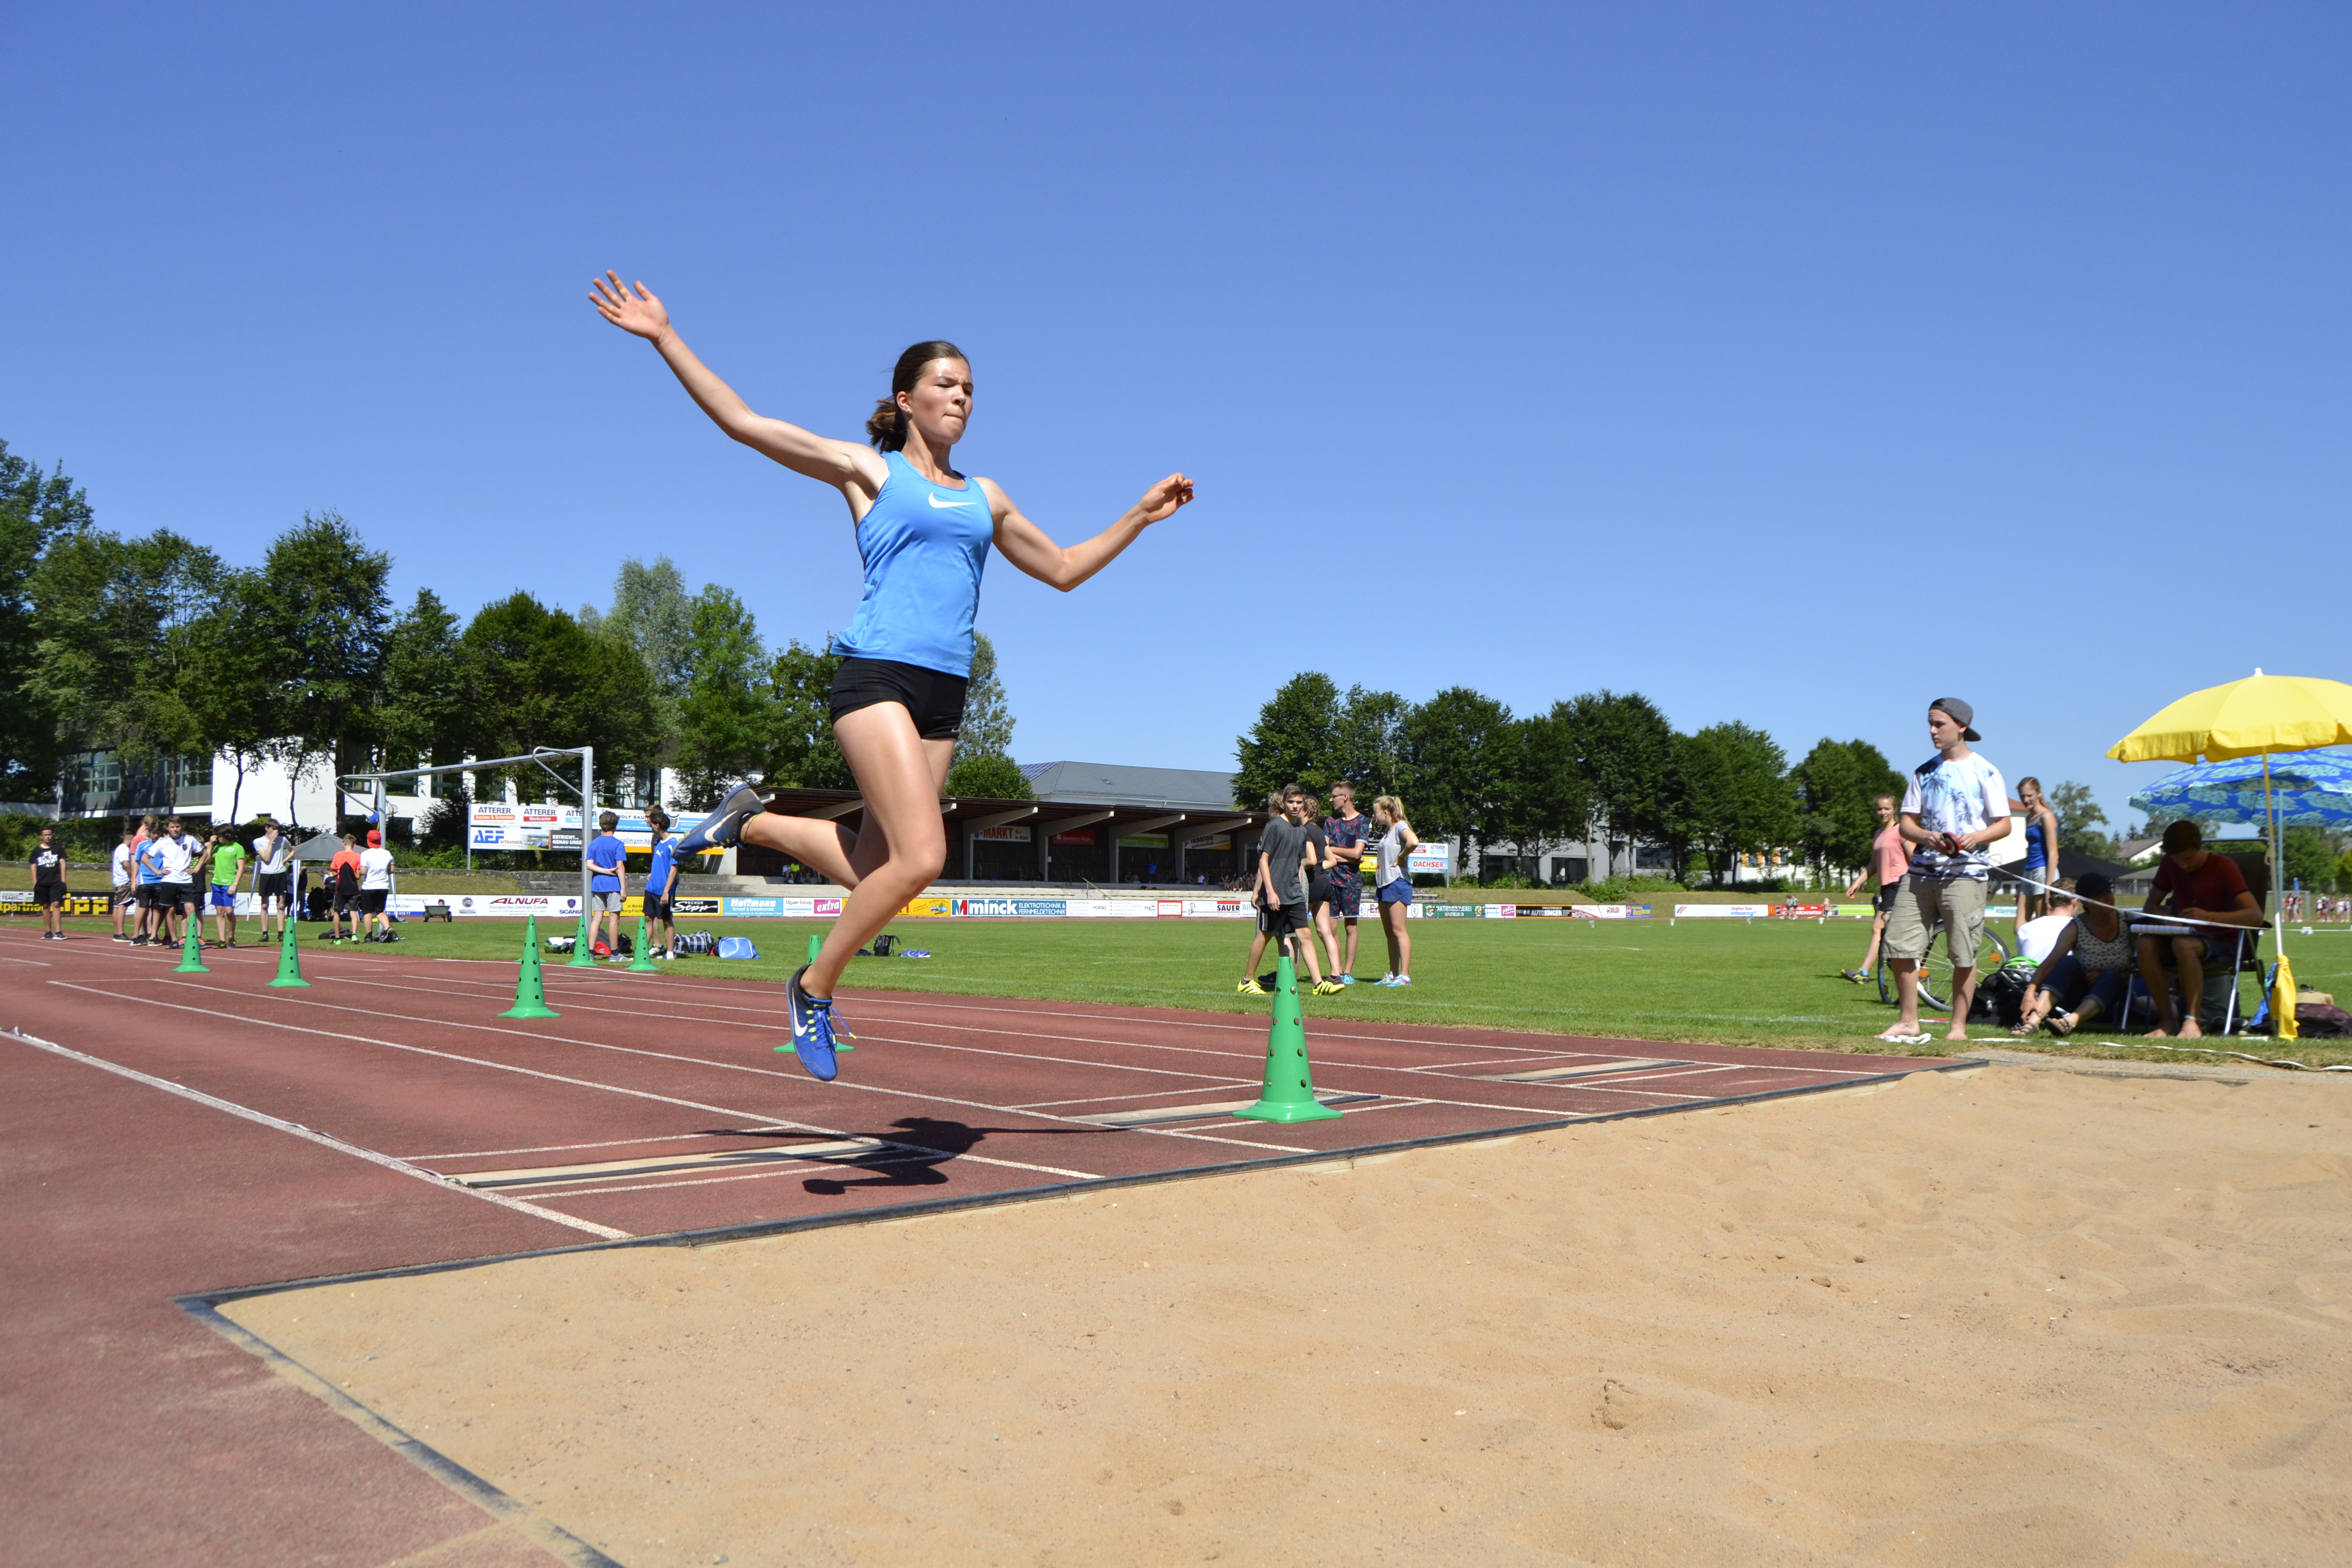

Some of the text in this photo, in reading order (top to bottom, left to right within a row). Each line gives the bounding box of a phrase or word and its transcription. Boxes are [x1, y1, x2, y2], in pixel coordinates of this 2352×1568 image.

[473, 830, 504, 844] AEF
[672, 901, 718, 912] Sepp
[730, 899, 776, 907] Hoffmann
[817, 900, 840, 912] extra
[969, 900, 1018, 915] minck
